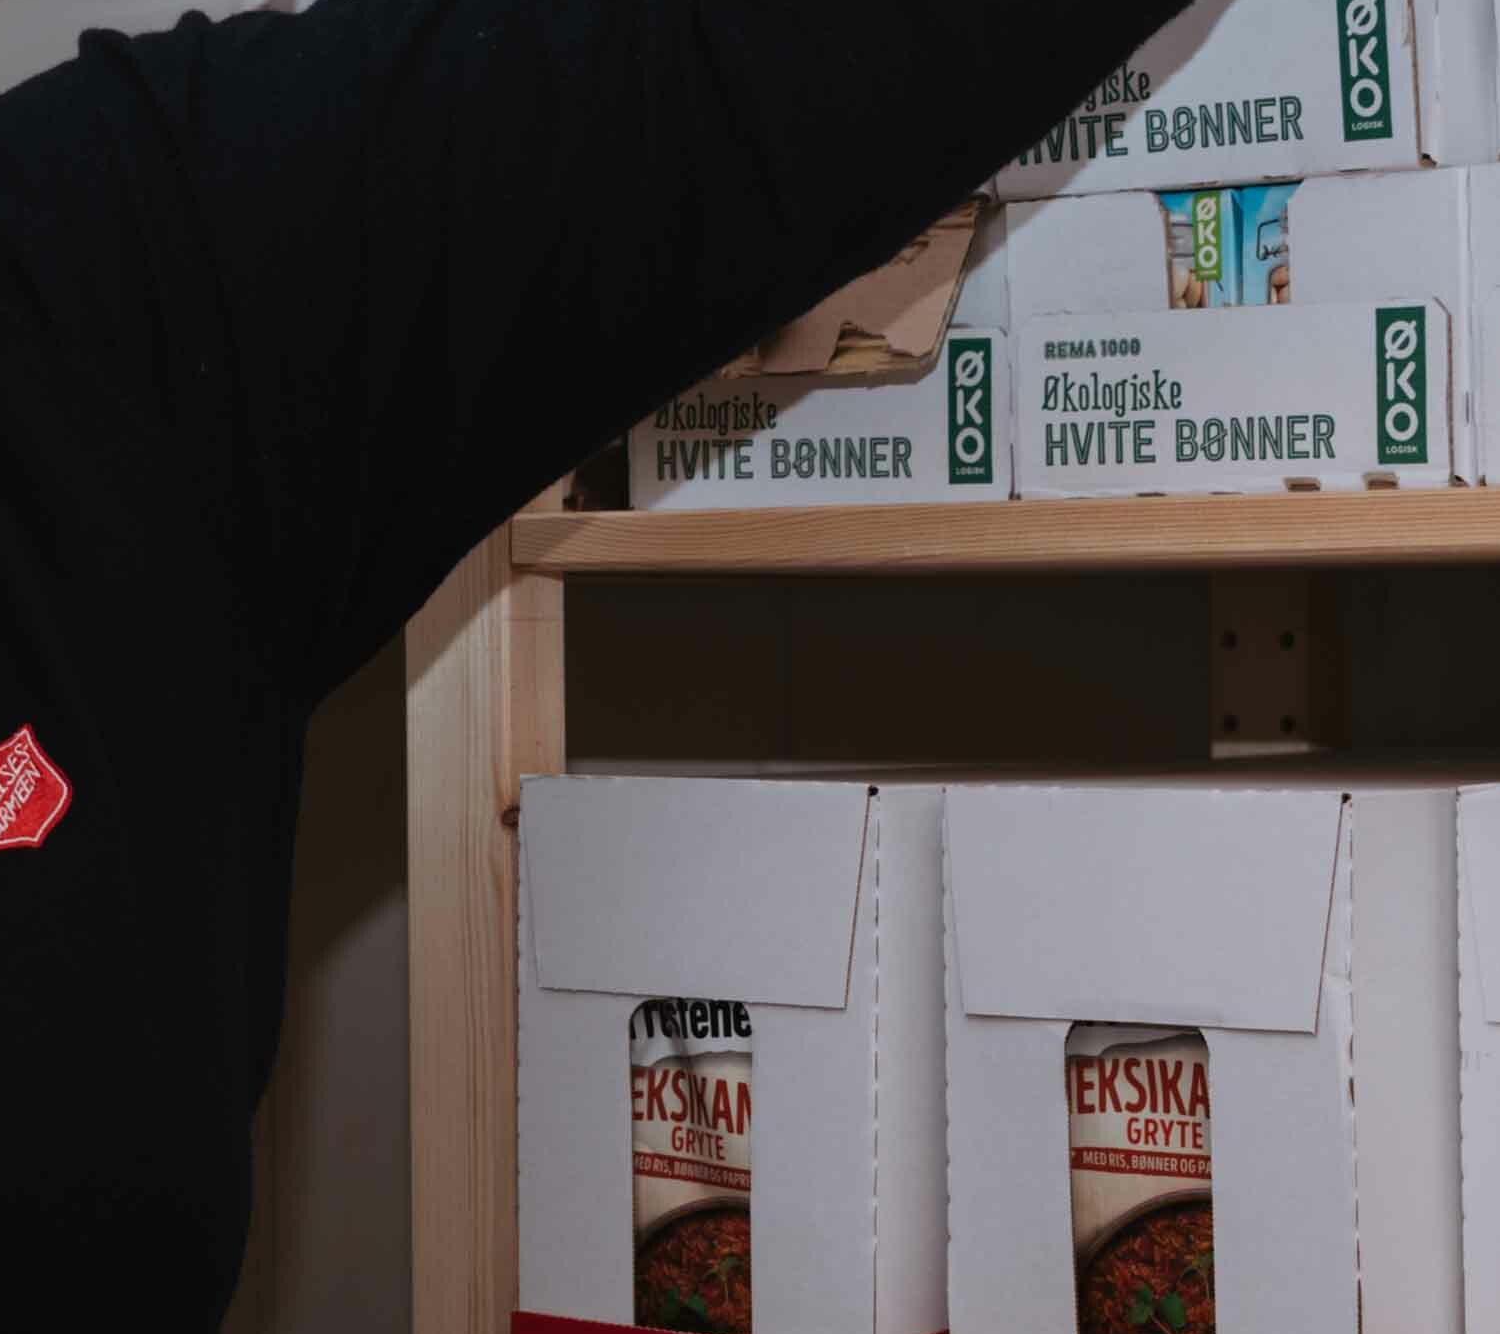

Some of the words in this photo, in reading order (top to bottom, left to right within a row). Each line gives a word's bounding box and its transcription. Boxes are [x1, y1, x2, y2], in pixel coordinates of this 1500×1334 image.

[1145, 95, 1304, 153] BØNNER
[1196, 197, 1218, 268] ØKO
[1044, 339, 1096, 360] REMA
[1100, 338, 1141, 358] 1000
[1041, 369, 1183, 418] Økologiske
[1383, 319, 1420, 442] ØKO
[654, 392, 778, 436] Økologiske
[954, 349, 985, 465] ØKO
[656, 438, 754, 482] HVITE
[770, 436, 913, 480] BØNNER
[1046, 420, 1157, 466] HVITE
[1175, 414, 1336, 463] BØNNER
[1065, 1056, 1210, 1119] EKSIKA
[671, 1125, 726, 1161] GRYTE
[1126, 1117, 1204, 1150] GRYTE
[1083, 1150, 1107, 1166] MED
[1109, 1152, 1130, 1170] RIS,
[1131, 1154, 1177, 1171] BØNNER
[1180, 1158, 1197, 1174] OG
